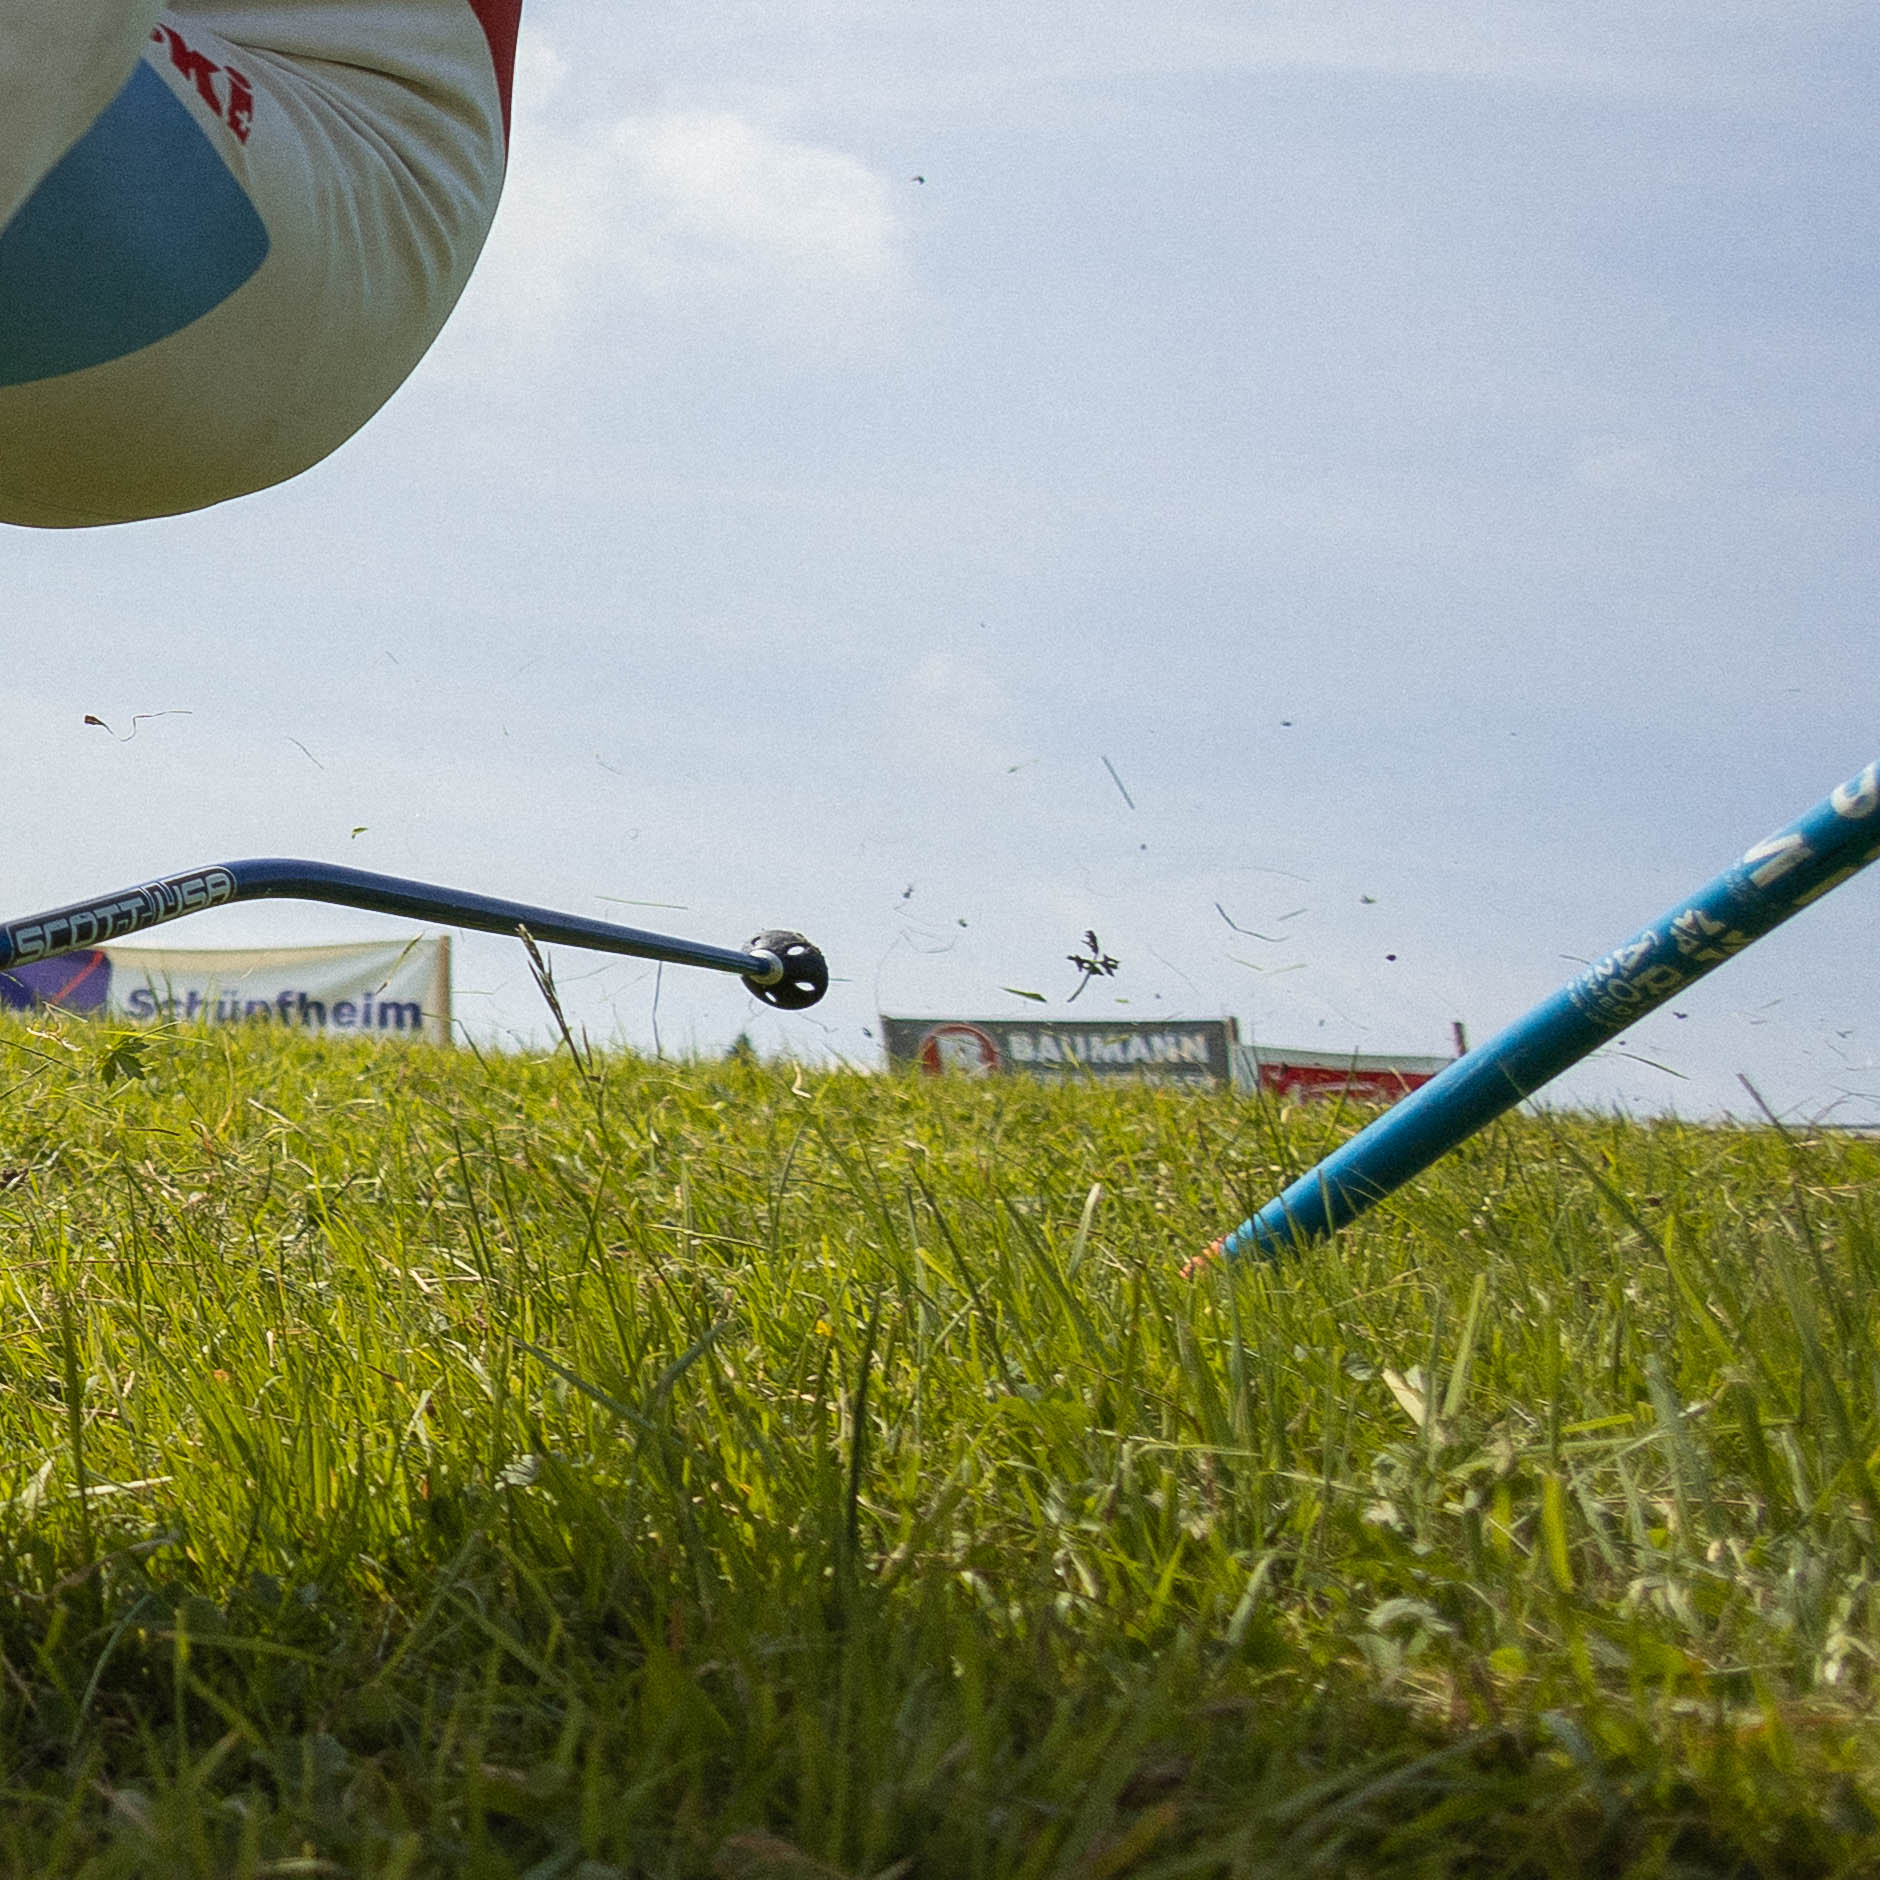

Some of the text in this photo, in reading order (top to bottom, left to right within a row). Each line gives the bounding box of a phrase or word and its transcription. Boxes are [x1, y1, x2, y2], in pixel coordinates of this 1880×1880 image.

[14, 872, 231, 965] SCOTT USA
[1008, 1031, 1210, 1065] BAUMANN
